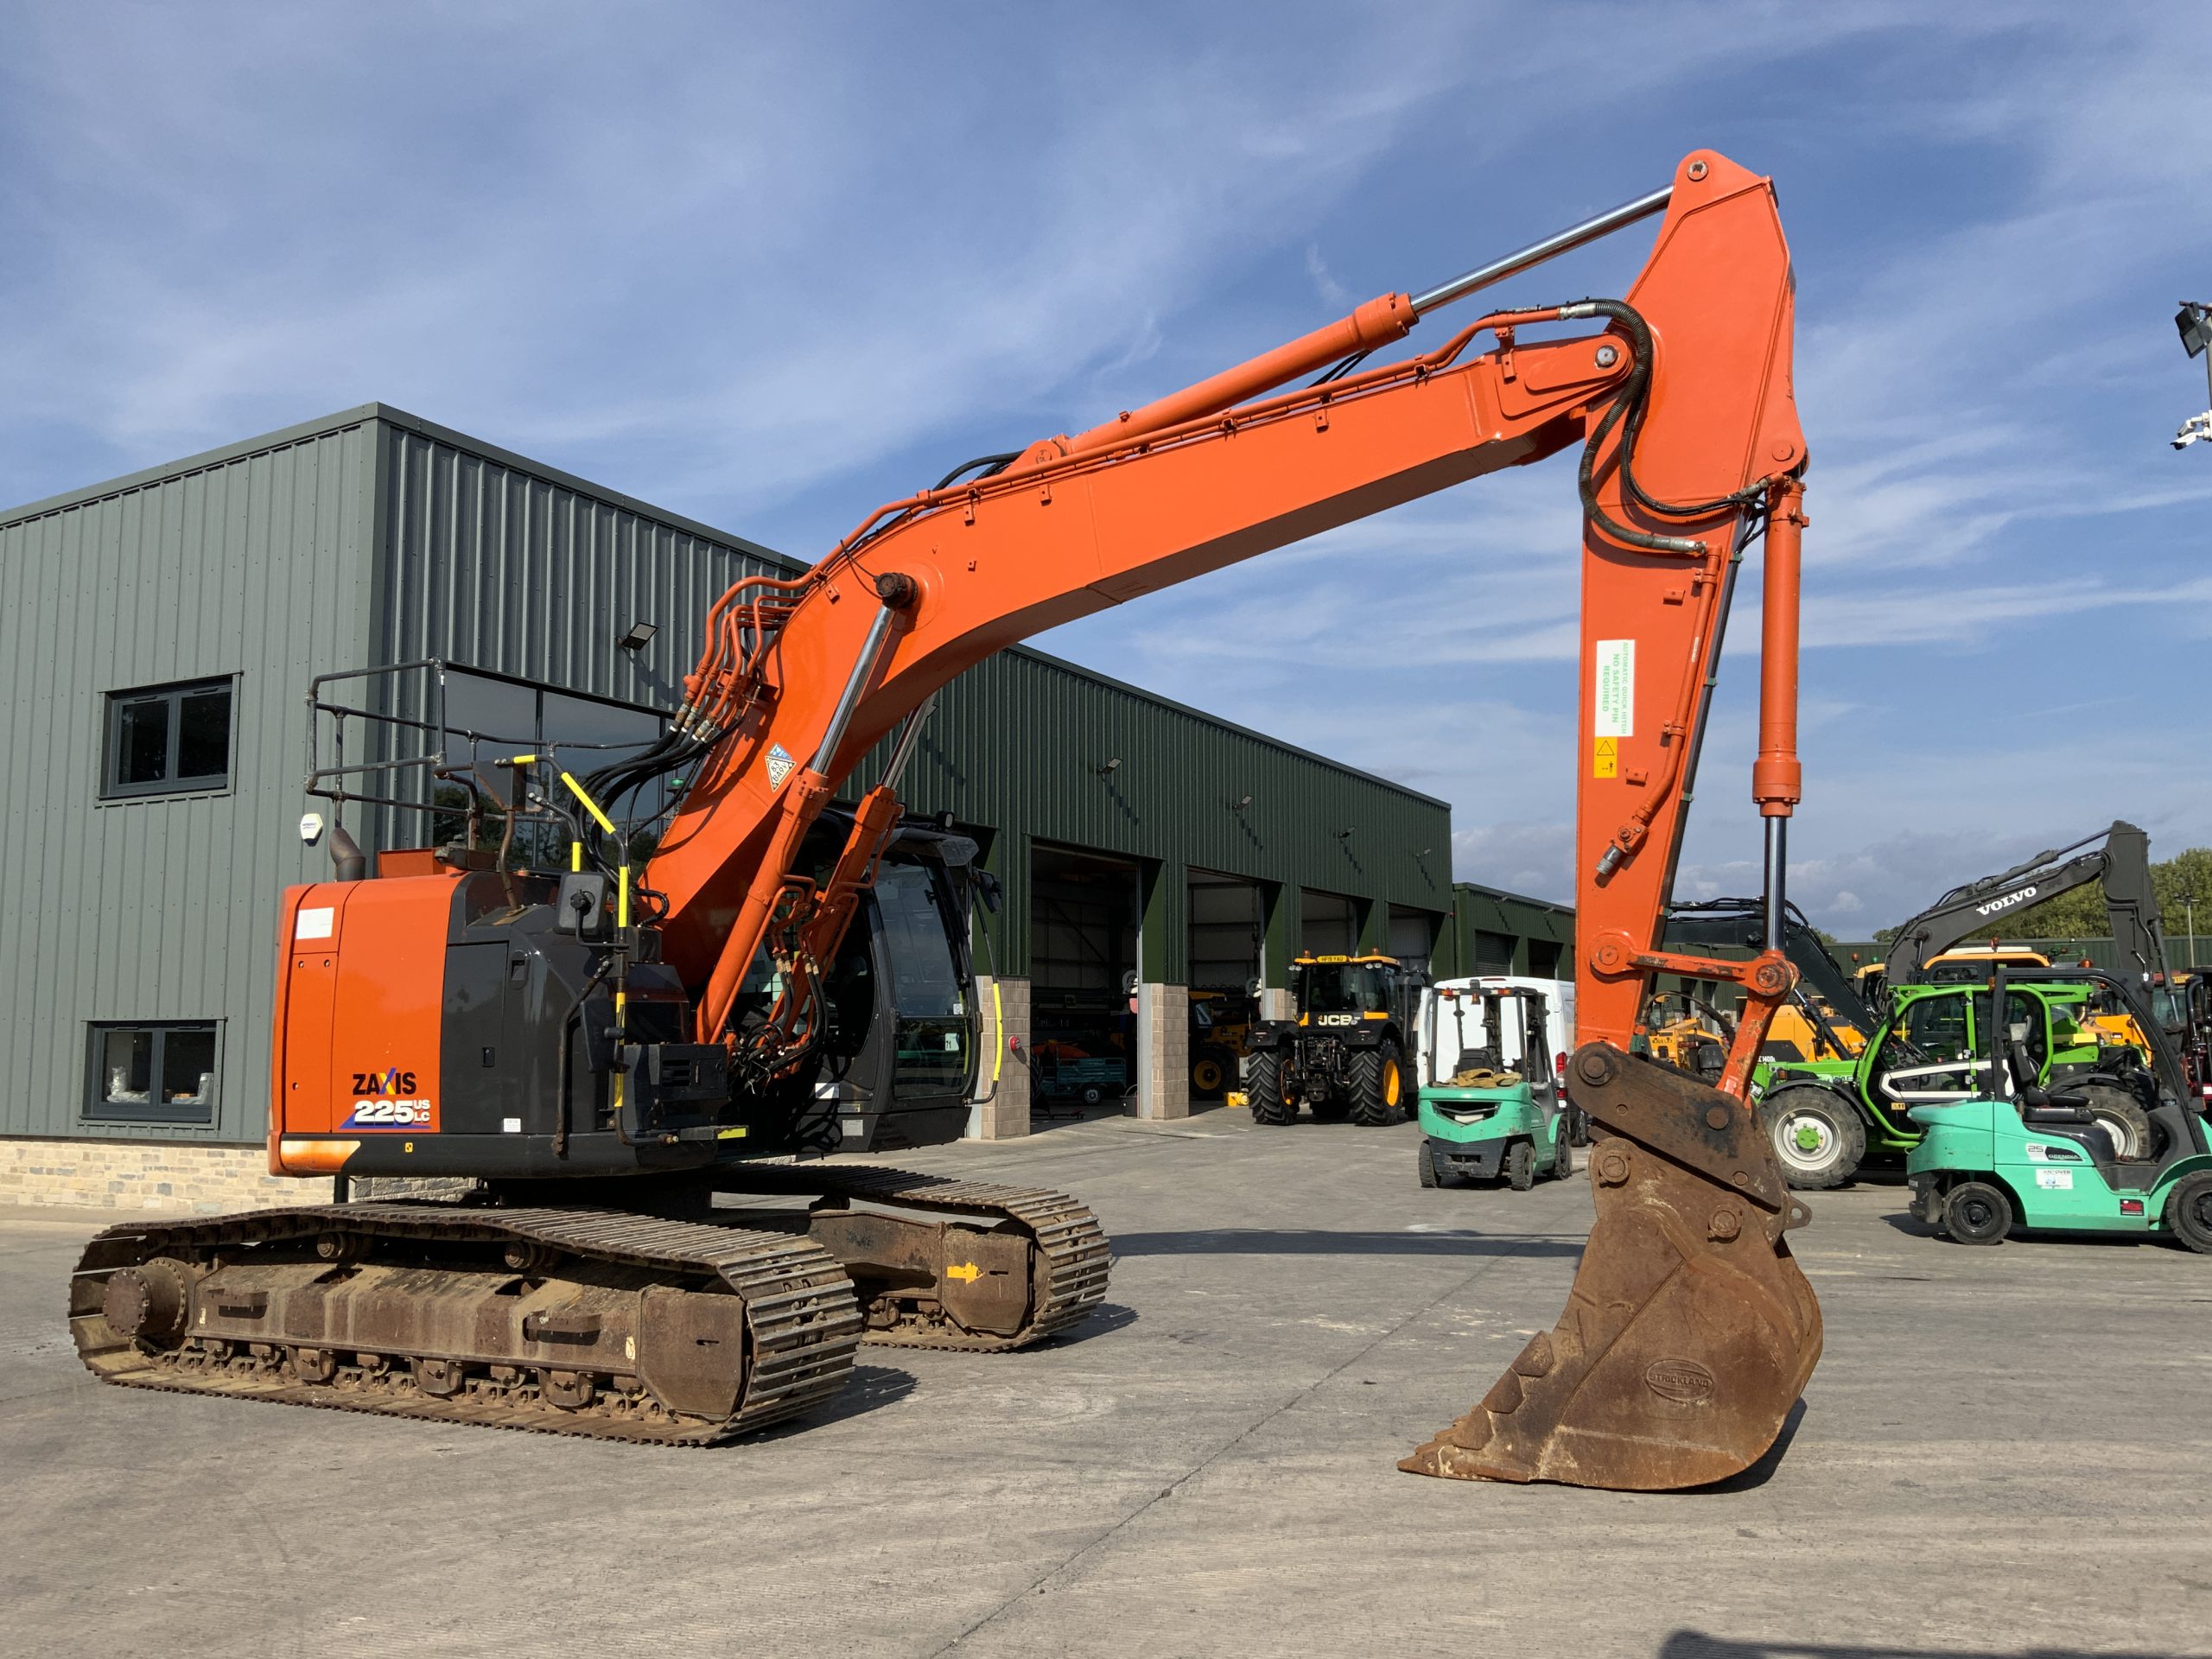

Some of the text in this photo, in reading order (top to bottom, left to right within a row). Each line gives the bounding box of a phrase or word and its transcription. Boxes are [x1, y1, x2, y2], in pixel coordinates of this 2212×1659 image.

[1612, 653, 1620, 667] NO
[1975, 887, 2037, 916] VOLVO
[1318, 1014, 1353, 1026] JCB
[353, 1067, 416, 1096] ZAXIS
[354, 1099, 430, 1126] 225 US
[415, 1111, 430, 1122] LC
[1649, 1373, 1709, 1388] STRICKLAND
